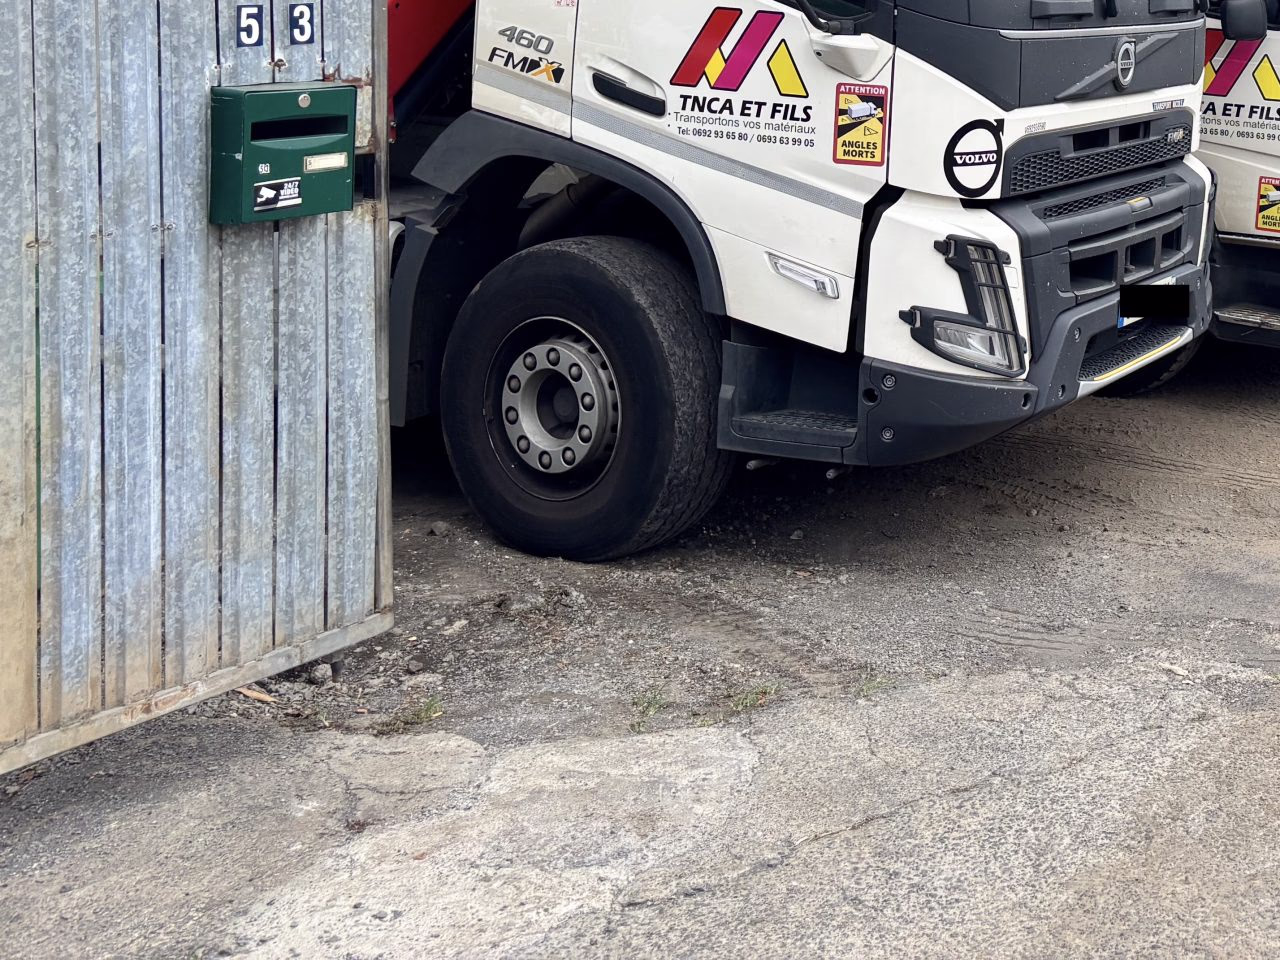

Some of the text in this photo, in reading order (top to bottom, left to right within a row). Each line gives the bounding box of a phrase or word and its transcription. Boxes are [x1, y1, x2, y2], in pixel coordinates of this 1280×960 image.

[498, 25, 554, 55] 460
[840, 85, 885, 95] ATTENTION
[680, 94, 813, 122] TNCA ET FILS
[1221, 103, 1245, 118] ET
[673, 111, 816, 135] Transportons vos matériaux
[1224, 119, 1240, 127] vos
[677, 126, 691, 136] Tel:
[692, 127, 712, 138] 0692
[714, 129, 724, 139] 93
[726, 131, 736, 140] 65
[738, 132, 748, 142] 80
[756, 134, 777, 144] 0693
[779, 136, 790, 146] 63
[791, 137, 802, 147] 99
[803, 138, 815, 148] 05
[1209, 128, 1219, 136] 65
[1220, 129, 1229, 137] 80
[1236, 130, 1255, 139] 0693
[1256, 132, 1265, 140] 63
[1266, 133, 1276, 141] 99
[841, 140, 878, 150] ANGLES
[842, 149, 876, 159] MORTS
[953, 152, 997, 164] VOLVO
[284, 181, 299, 190] 24/7
[280, 187, 299, 197] VIDEO
